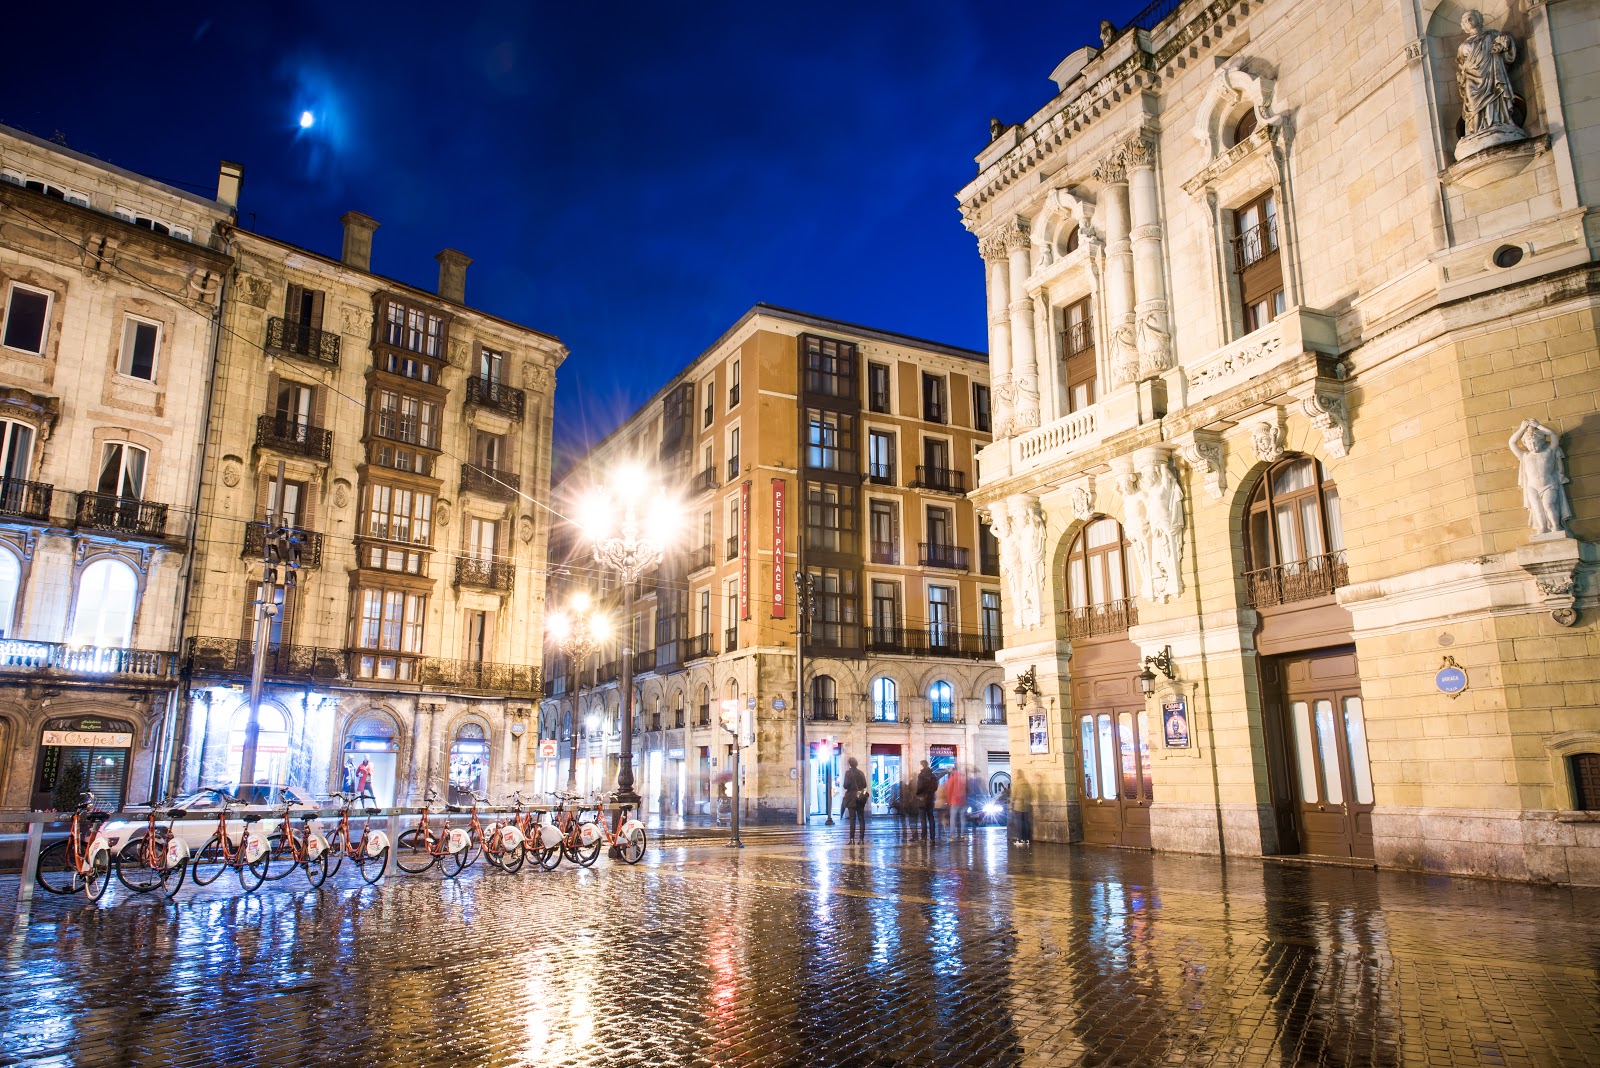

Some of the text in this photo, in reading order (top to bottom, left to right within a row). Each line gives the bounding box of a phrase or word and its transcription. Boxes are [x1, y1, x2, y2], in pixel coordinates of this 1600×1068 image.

[64, 732, 115, 746] Crepes
[44, 745, 52, 778] ELADOS
[50, 747, 59, 788] RTESANOS
